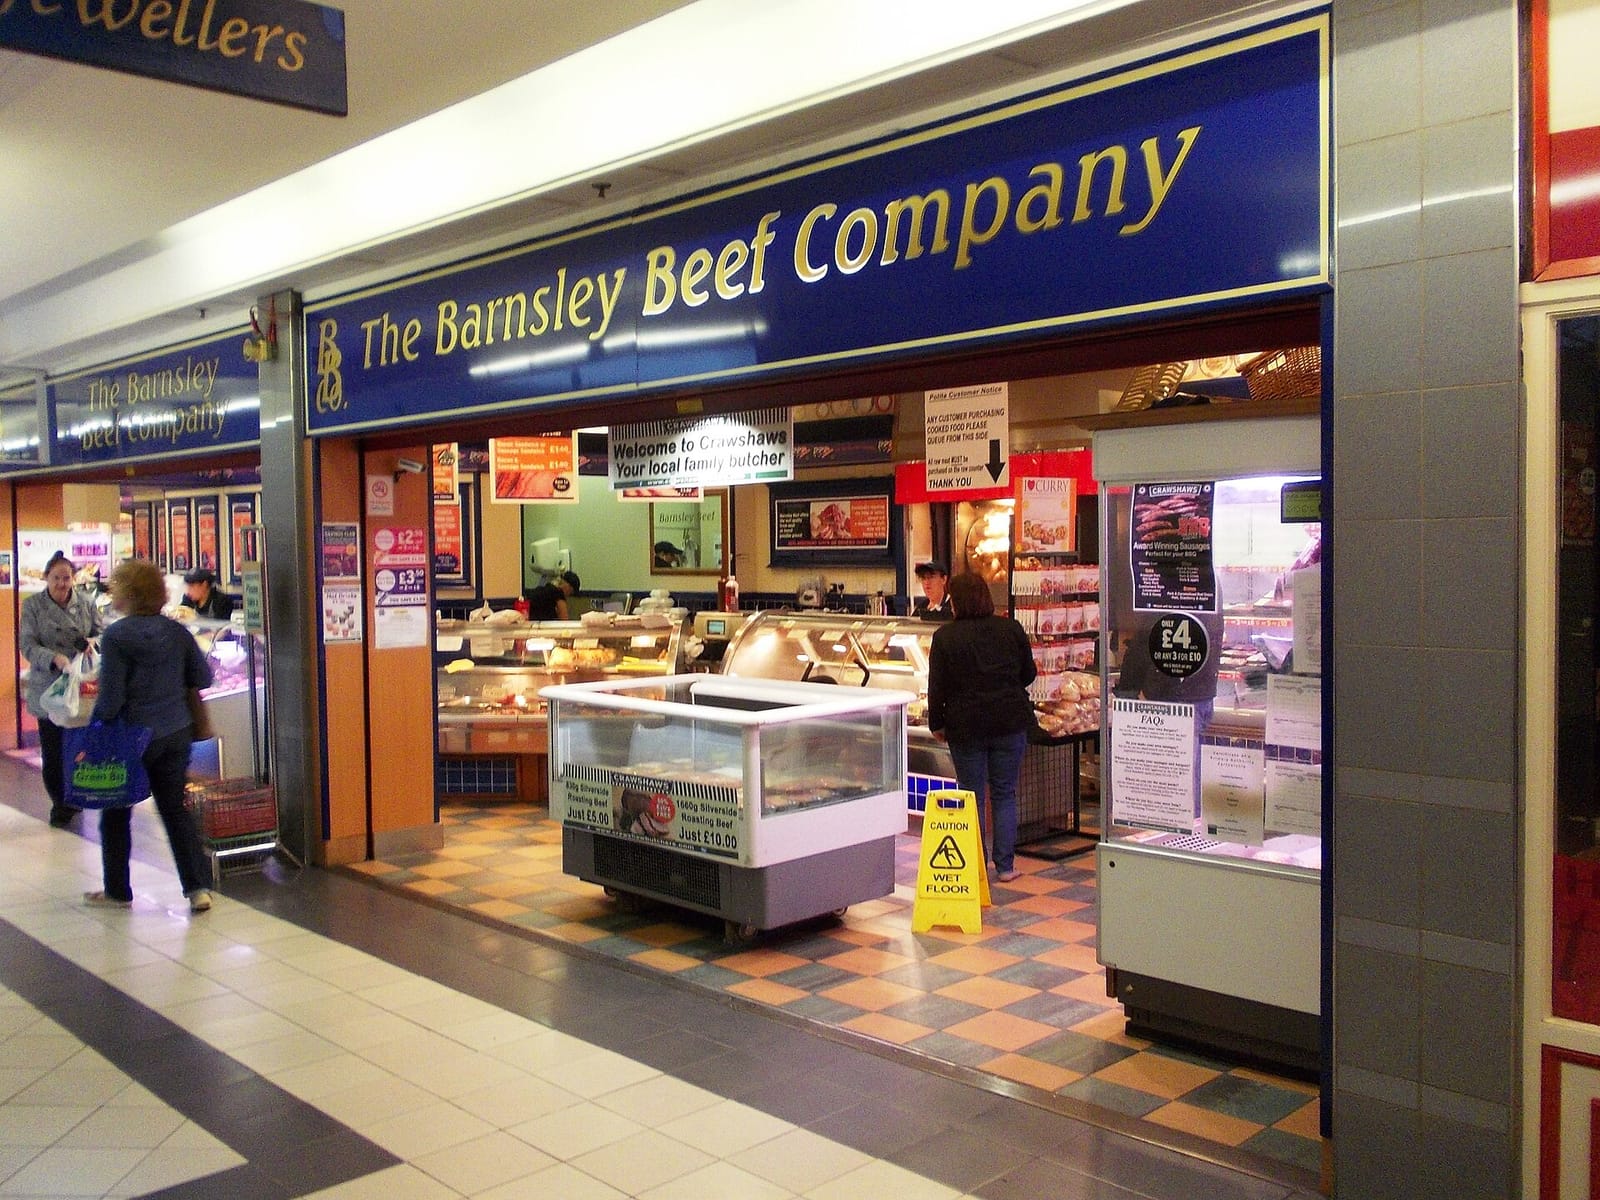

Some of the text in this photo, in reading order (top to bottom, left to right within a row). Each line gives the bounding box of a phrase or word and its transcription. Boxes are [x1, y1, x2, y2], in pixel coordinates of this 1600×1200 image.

[361, 126, 1202, 370] The Barnsley Beef Company
[88, 356, 220, 412] The Barnsley
[948, 390, 979, 398] Customer
[980, 386, 1002, 394] Notice
[128, 400, 229, 445] Company
[927, 408, 1004, 424] ANY CUSTOMER PURCHASING
[927, 420, 987, 434] COOKED FOOD PLEASE
[613, 430, 787, 460] Welcome to Crawshaws
[927, 431, 988, 445] QUEUE FROM THIS SIDE
[616, 449, 786, 478] Your local family butcher
[929, 476, 971, 488] THANK YOU
[1035, 479, 1069, 492] CURRY
[1152, 485, 1198, 495] CRAWSHAWS
[1132, 541, 1210, 552] Award Winning Sausages
[1161, 619, 1174, 628] ONLY
[1162, 619, 1191, 649] £4
[1153, 651, 1201, 662] OR ANY 3 FOR £10
[1141, 715, 1165, 726] FAQs
[613, 774, 670, 790] CRAWSHAWS
[580, 784, 609, 797] Silverside
[567, 792, 608, 808] Roasting Beef
[676, 800, 698, 812] 1660g
[700, 803, 737, 817] Silverside
[567, 807, 609, 826] Just £5.00
[681, 813, 733, 829] Roasting Beef
[930, 821, 969, 831] CAUTION
[679, 826, 737, 849] Just £10.00
[933, 873, 961, 882] WET
[926, 884, 969, 894] FLOOR
